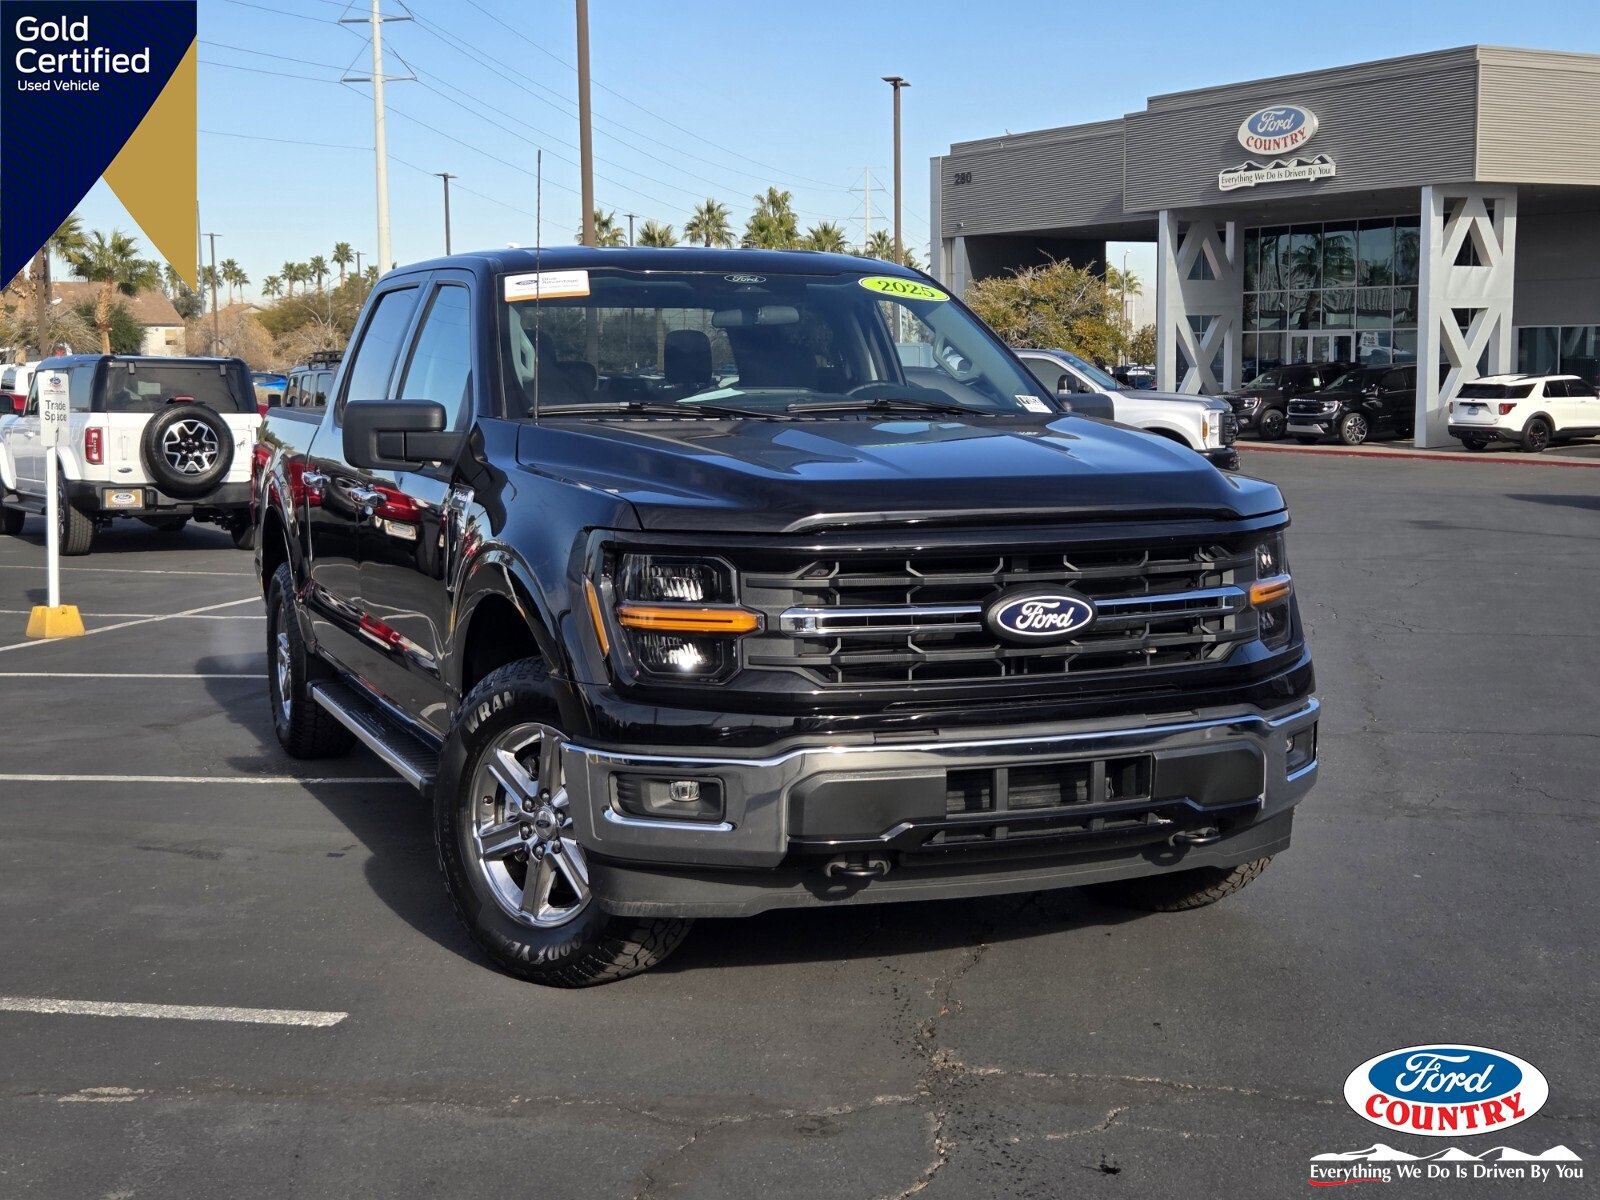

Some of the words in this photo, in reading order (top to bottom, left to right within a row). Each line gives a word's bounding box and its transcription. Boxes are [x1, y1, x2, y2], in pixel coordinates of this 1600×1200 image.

[1257, 110, 1294, 133] Ford
[1246, 127, 1307, 151] COUNTRY
[1221, 173, 1253, 184] Everything
[1254, 172, 1265, 181] We
[1266, 171, 1276, 180] Do
[1277, 170, 1283, 179] Is
[1284, 168, 1306, 178] Driven
[1307, 167, 1316, 177] By
[1318, 166, 1331, 176] You
[732, 274, 760, 283] Ford
[877, 280, 935, 298] 2025
[45, 400, 67, 411] Trade
[44, 411, 68, 423] Space
[1016, 602, 1075, 629] Ford
[464, 690, 516, 734] WRAN
